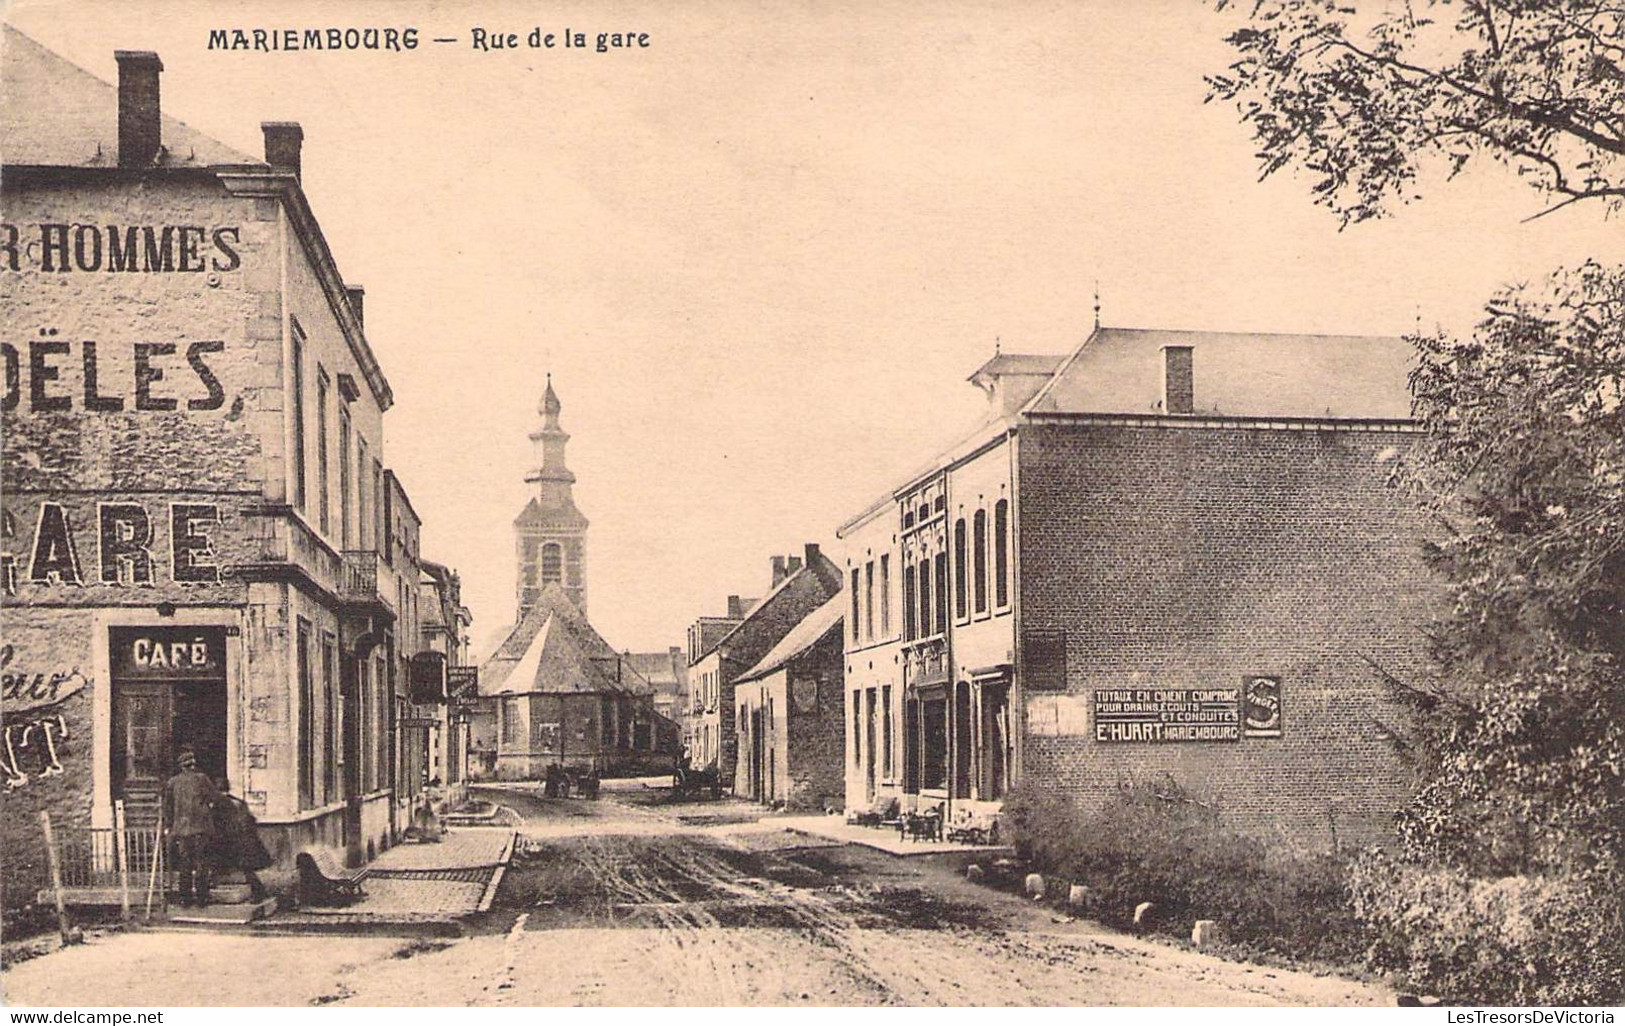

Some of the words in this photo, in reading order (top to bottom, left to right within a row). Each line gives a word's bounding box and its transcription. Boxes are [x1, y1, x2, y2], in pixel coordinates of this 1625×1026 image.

[39, 222, 241, 273] HOMMES
[134, 637, 208, 668] CAFÉ
[1136, 691, 1150, 702] EN
[1096, 702, 1121, 711] POUR
[1161, 712, 1175, 721] ET
[1177, 711, 1239, 721] CONDUITES
